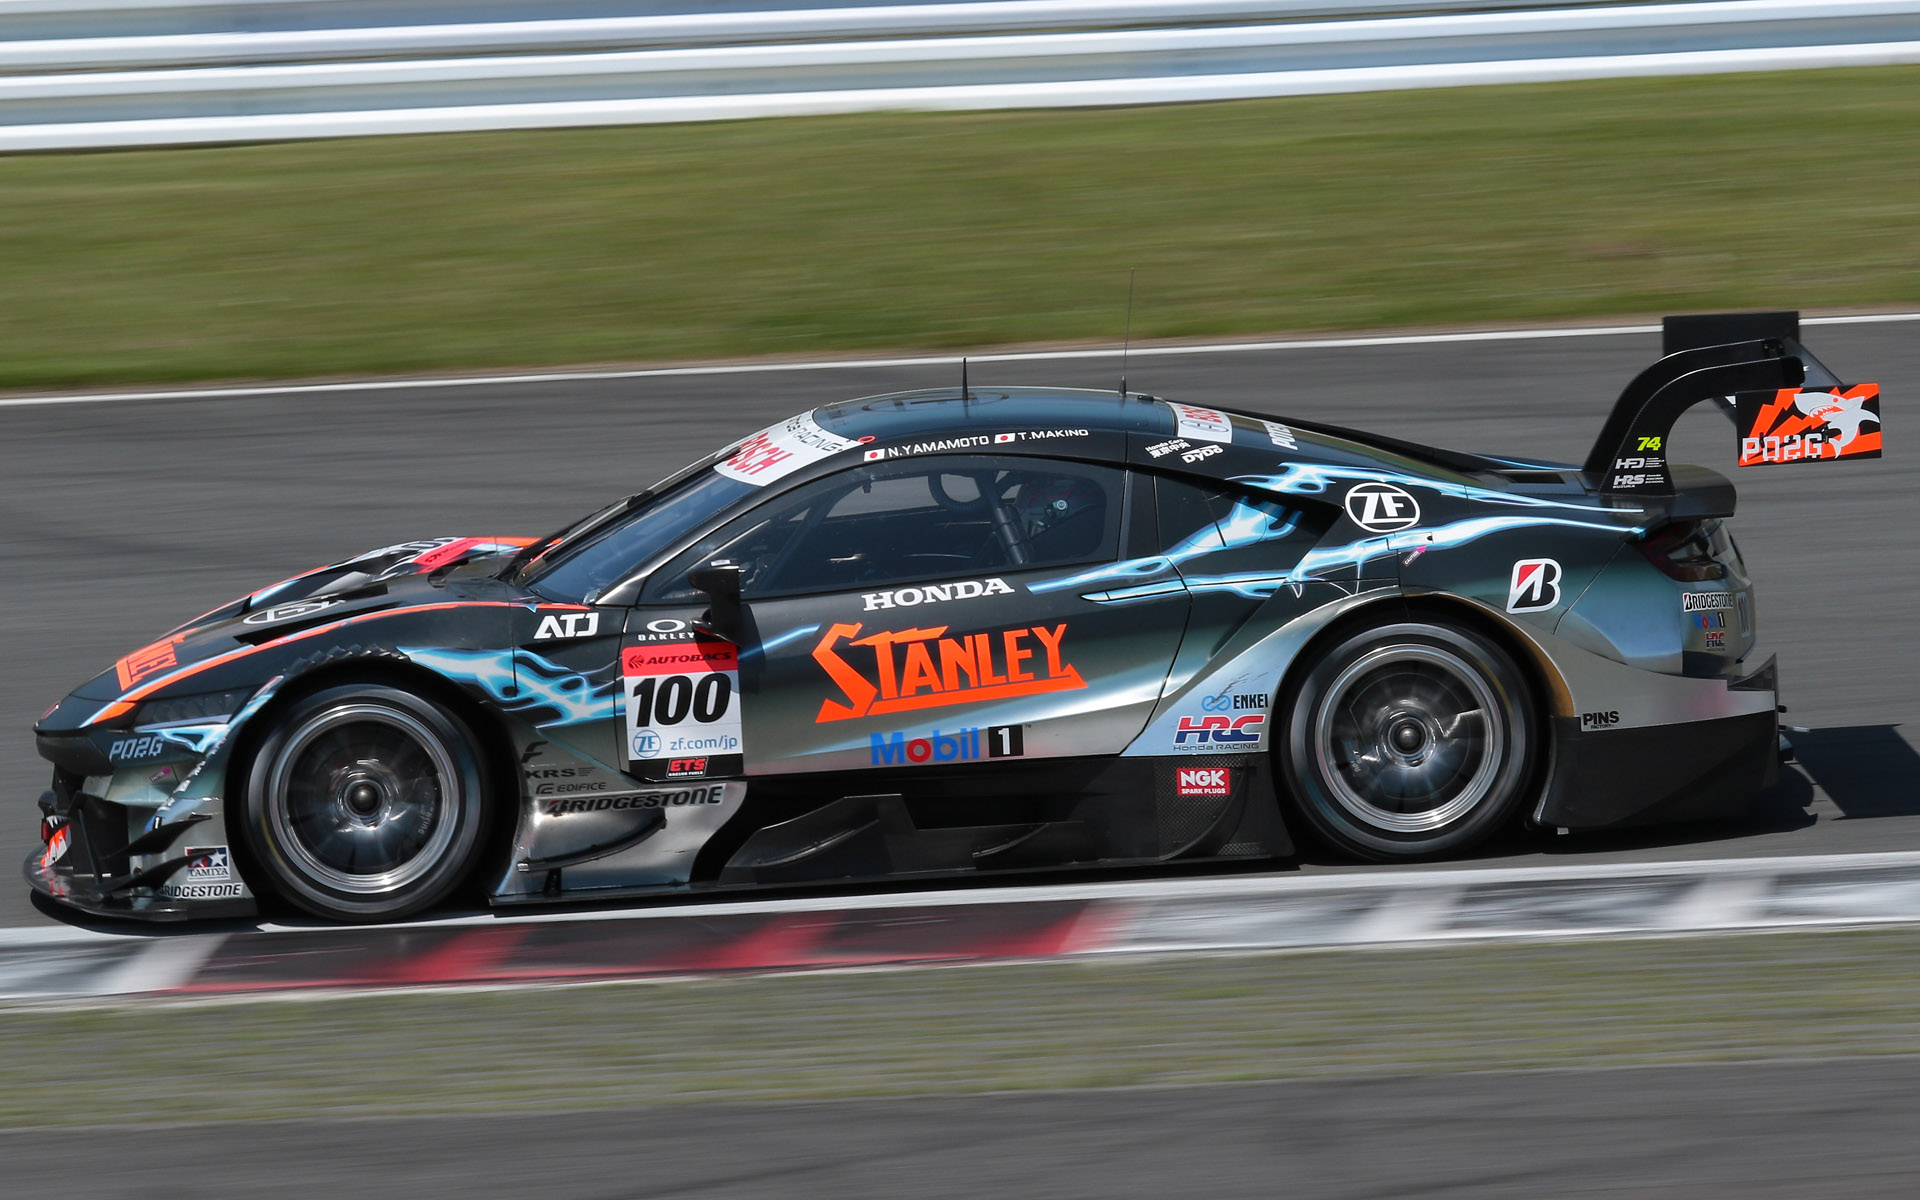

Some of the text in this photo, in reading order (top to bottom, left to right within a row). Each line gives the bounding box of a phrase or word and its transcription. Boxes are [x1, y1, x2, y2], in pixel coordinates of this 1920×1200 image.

[793, 427, 843, 452] RACING
[1018, 429, 1089, 441] T.MAKINO
[888, 436, 989, 457] N.YAMAMOTO
[1637, 436, 1661, 451] 74
[1613, 474, 1646, 486] HRS
[1349, 488, 1416, 528] ZF
[861, 577, 1015, 611] HONDA
[1683, 593, 1733, 611] BRIDGESTONE
[638, 631, 695, 642] OAKLEY
[1705, 632, 1725, 648] HRC
[646, 652, 732, 665] AUTOBACS
[811, 622, 1088, 723] STANLEY
[632, 673, 732, 728] 100
[1233, 694, 1269, 709] ENKEI
[1582, 711, 1620, 726] PINS
[1173, 714, 1266, 744] HRC
[634, 733, 661, 756] ZF
[670, 736, 738, 752] zf.com/jp
[870, 727, 980, 765] Mobil
[670, 758, 706, 772] ETS
[525, 768, 576, 779] KRS
[1180, 770, 1226, 787] NGK
[557, 782, 607, 792] EDIFICE
[548, 785, 724, 813] BRIDGESTONE
[188, 867, 229, 877] TAMIYA
